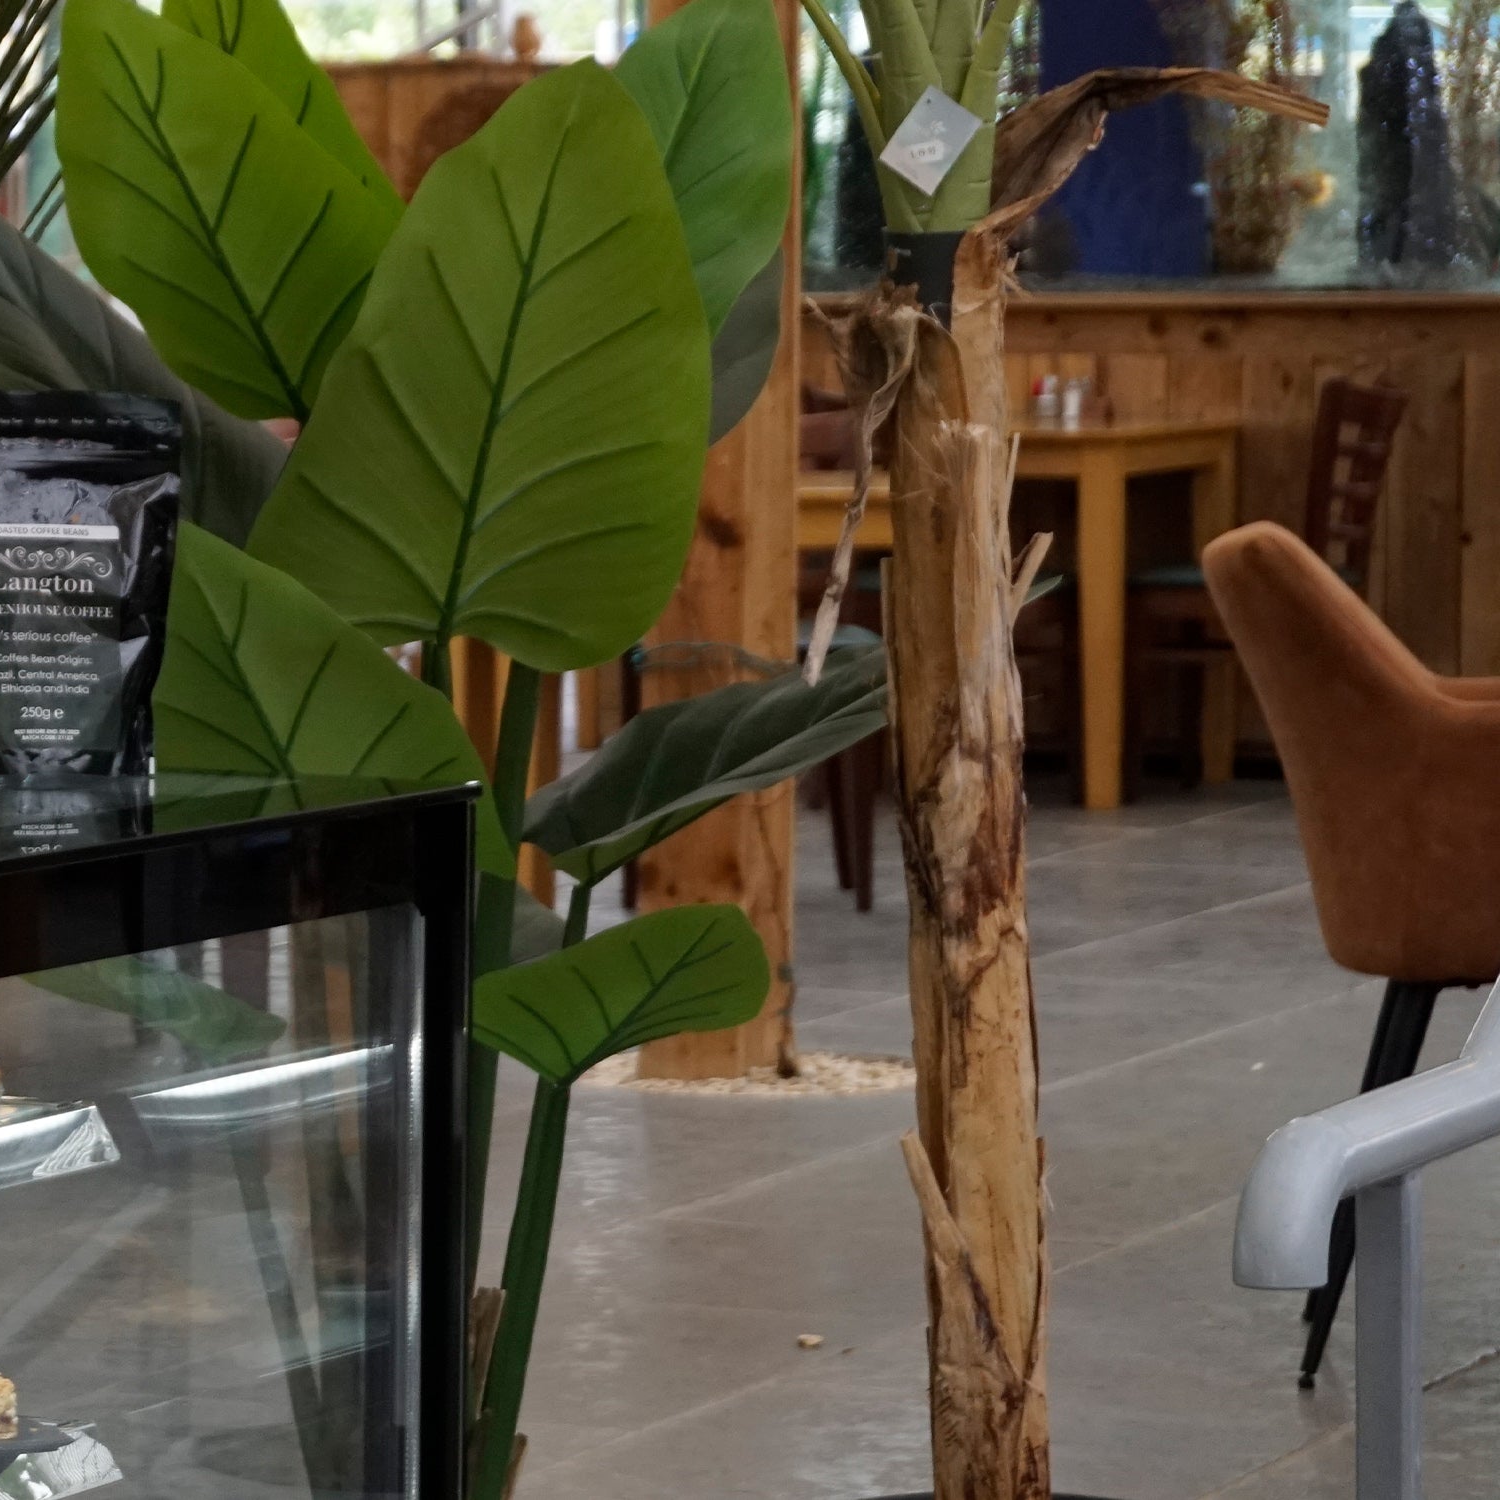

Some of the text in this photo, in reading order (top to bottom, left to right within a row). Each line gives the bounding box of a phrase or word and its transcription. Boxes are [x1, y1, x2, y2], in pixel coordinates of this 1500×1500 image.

[31, 526, 60, 536] COFFEE
[62, 527, 90, 537] BEANS
[62, 606, 114, 619] COFFEE
[12, 630, 51, 642] serious
[31, 653, 56, 664] Bean
[18, 669, 55, 681] Central
[1, 684, 90, 695] Ethiopia and India
[20, 706, 51, 720] 250g
